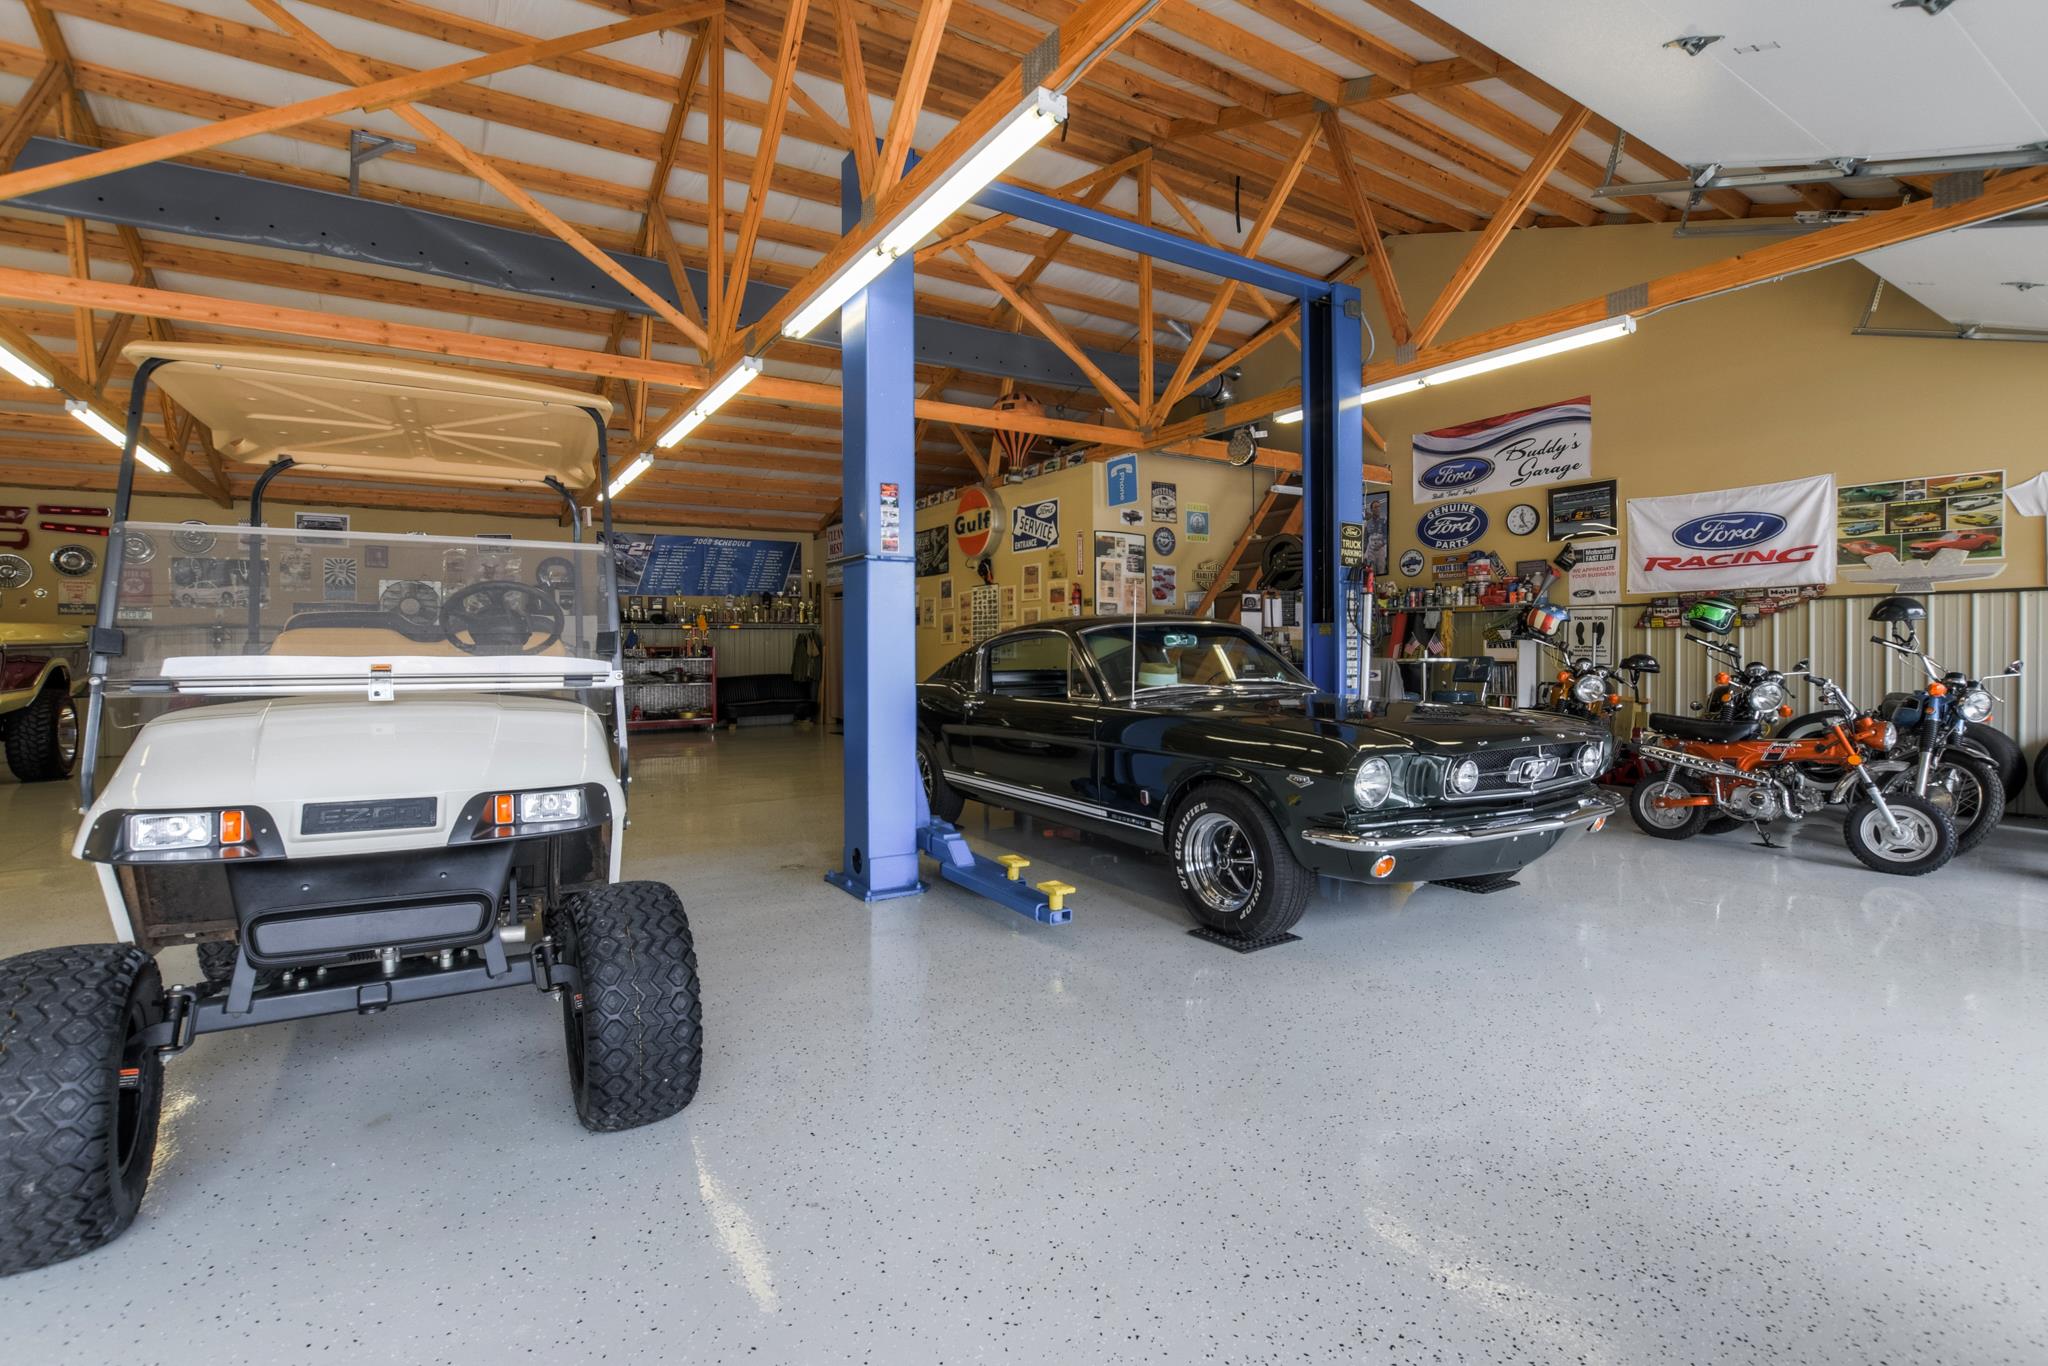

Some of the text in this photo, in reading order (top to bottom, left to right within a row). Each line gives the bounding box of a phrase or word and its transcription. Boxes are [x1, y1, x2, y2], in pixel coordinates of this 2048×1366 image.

[1494, 432, 1582, 461] Buddy's
[1434, 463, 1476, 485] Ford
[1510, 456, 1582, 487] Garage
[1038, 505, 1054, 516] Ford
[1427, 503, 1476, 519] GENUINE
[955, 510, 991, 535] Gulf
[1019, 516, 1053, 541] SERVICE
[1428, 516, 1474, 536] Ford
[1694, 518, 1764, 544] Ford
[628, 541, 646, 556] 2
[713, 539, 752, 547] SCHEDULE
[1015, 538, 1037, 550] ENTRANCE
[1341, 549, 1362, 557] PARKING
[1342, 539, 1361, 549] TRUCK
[1435, 538, 1469, 550] PARTS
[1644, 545, 1818, 571] RACING
[1770, 588, 1798, 596] Mobil
[1175, 802, 1208, 860] QUALIFIER
[1176, 866, 1189, 890] G/T
[1240, 868, 1263, 920] DUNLOP
